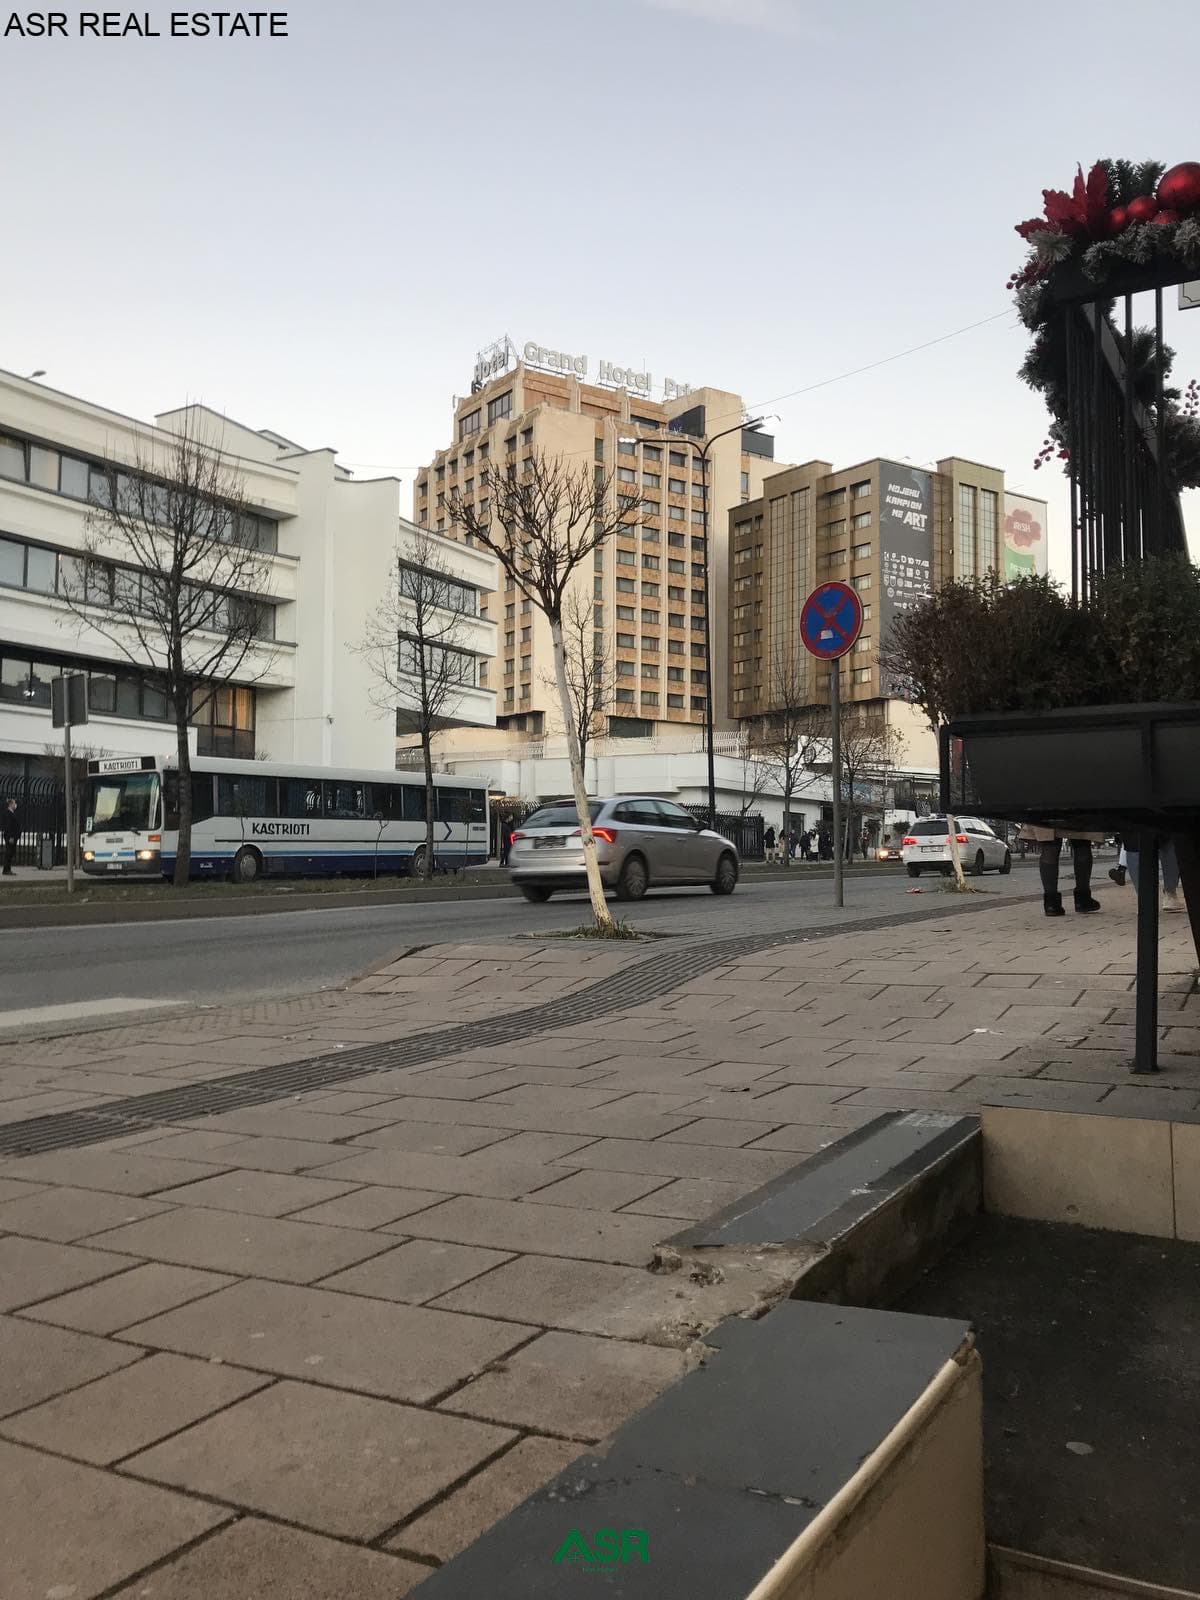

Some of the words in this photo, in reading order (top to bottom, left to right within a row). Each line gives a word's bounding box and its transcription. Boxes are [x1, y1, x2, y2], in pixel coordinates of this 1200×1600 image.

[474, 346, 509, 381] Hotel
[524, 341, 588, 373] Grand
[599, 359, 652, 392] Hotel
[903, 511, 928, 528] ART
[103, 761, 138, 771] KASTRIOTI
[252, 822, 310, 836] KASTRIOTI
